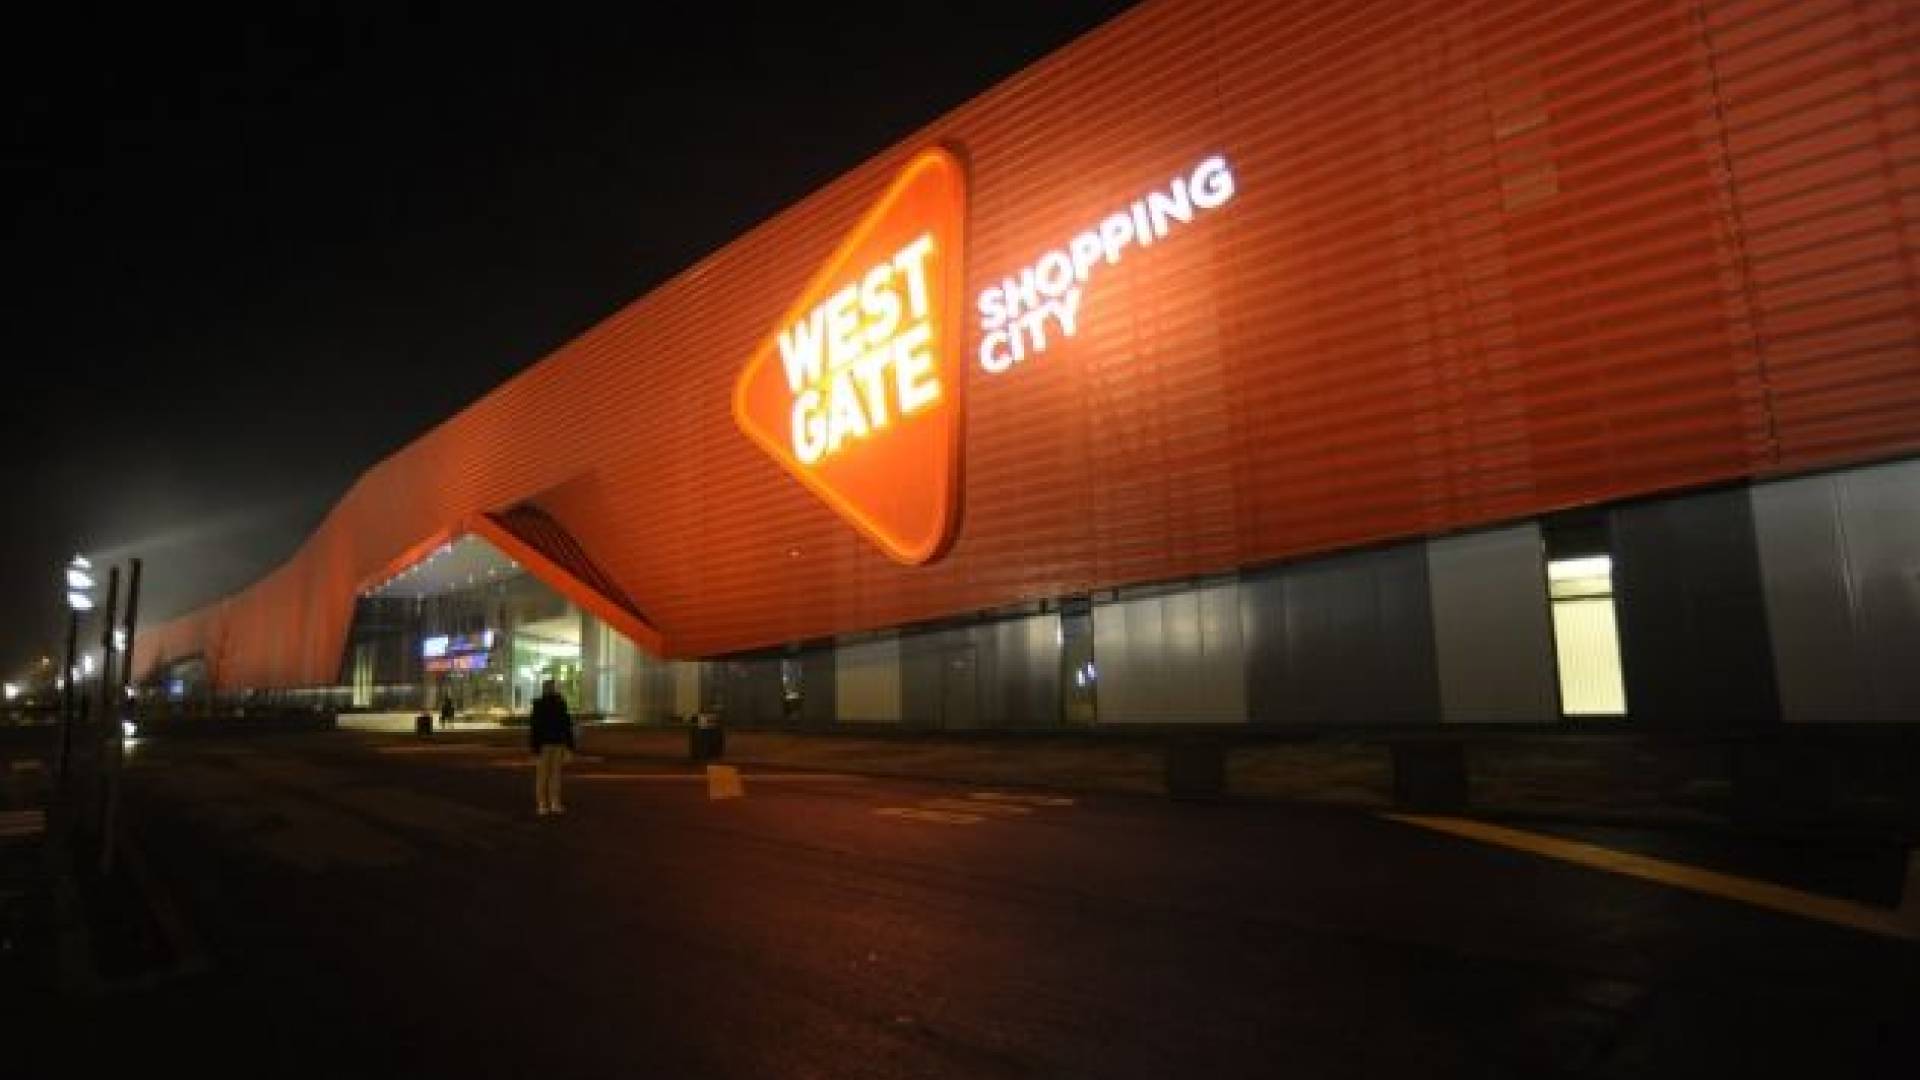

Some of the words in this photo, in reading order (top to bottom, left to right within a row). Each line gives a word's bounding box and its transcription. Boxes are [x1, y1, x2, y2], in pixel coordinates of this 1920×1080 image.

[779, 234, 933, 390] WEST
[979, 156, 1235, 328] SHOPPING
[791, 323, 941, 464] GATE
[979, 291, 1082, 373] CITY
